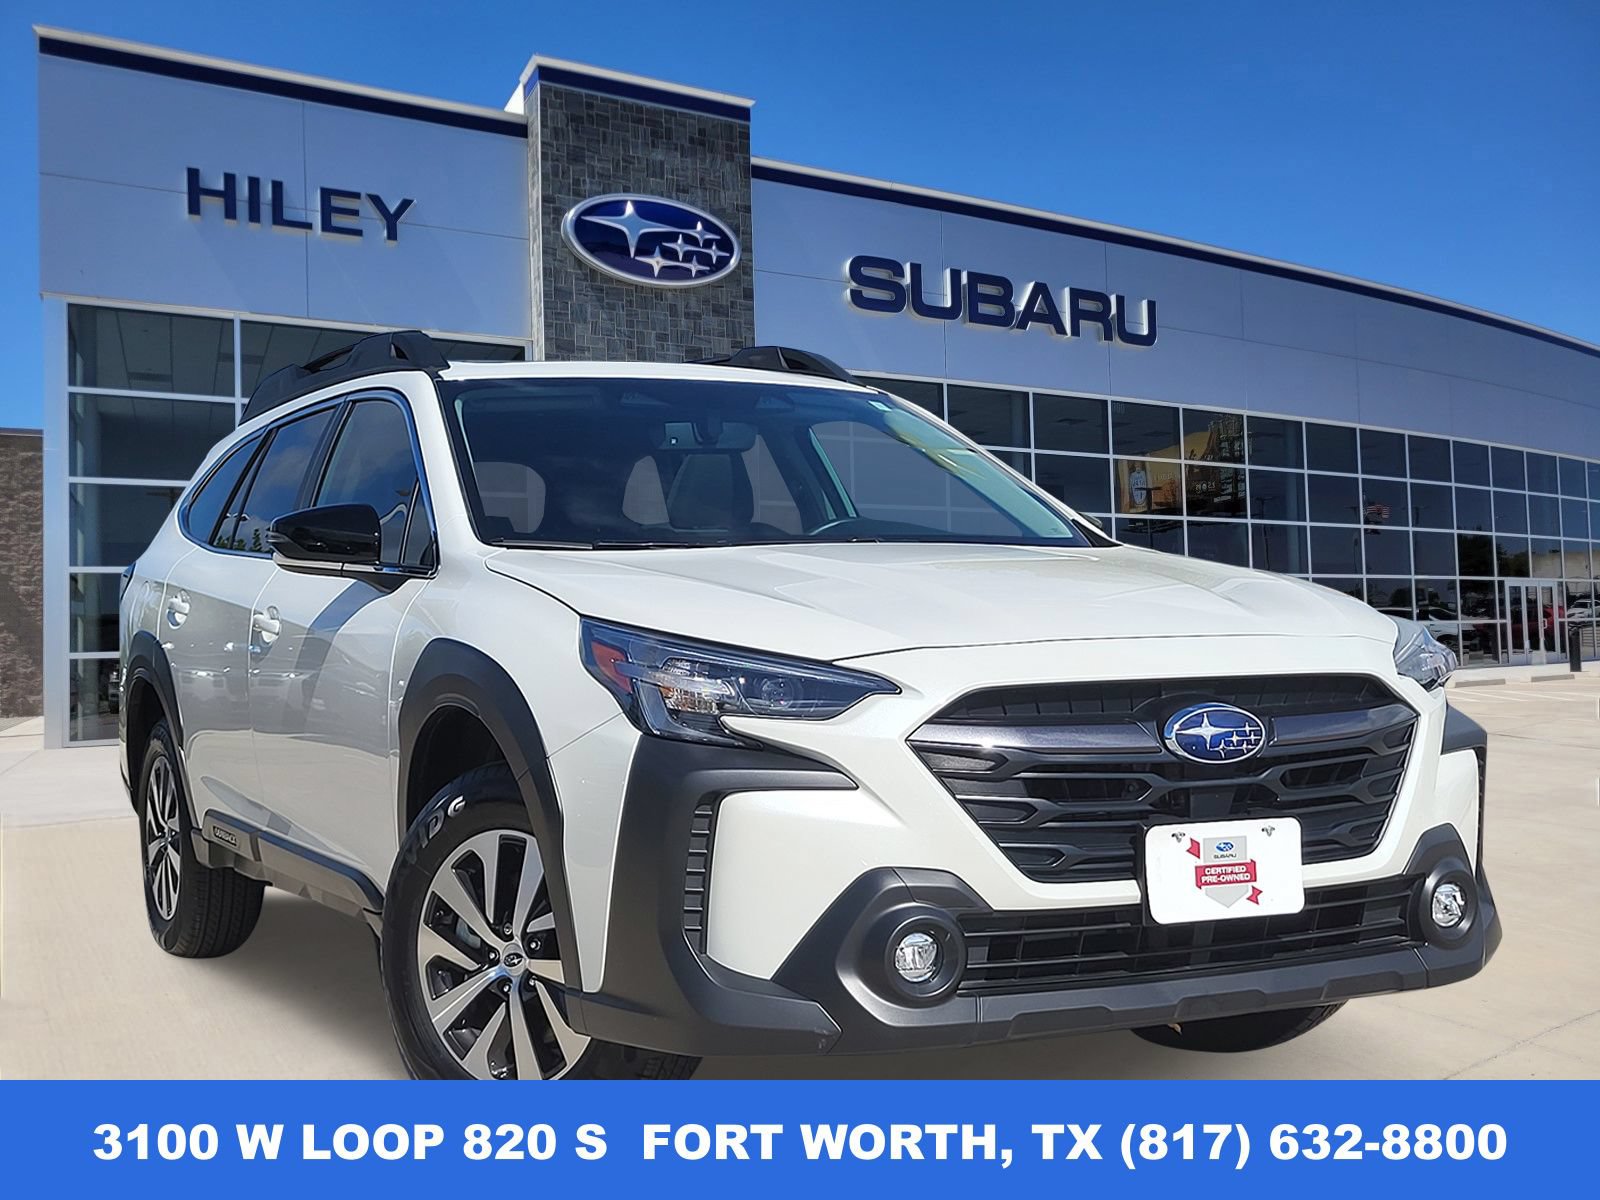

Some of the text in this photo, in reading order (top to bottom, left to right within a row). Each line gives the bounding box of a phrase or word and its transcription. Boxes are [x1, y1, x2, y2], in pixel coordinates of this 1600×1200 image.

[186, 166, 415, 241] HILEY
[848, 255, 1158, 347] SUBARU
[1201, 873, 1251, 883] PRE-OWNED
[1205, 865, 1246, 874] CERTIFIED
